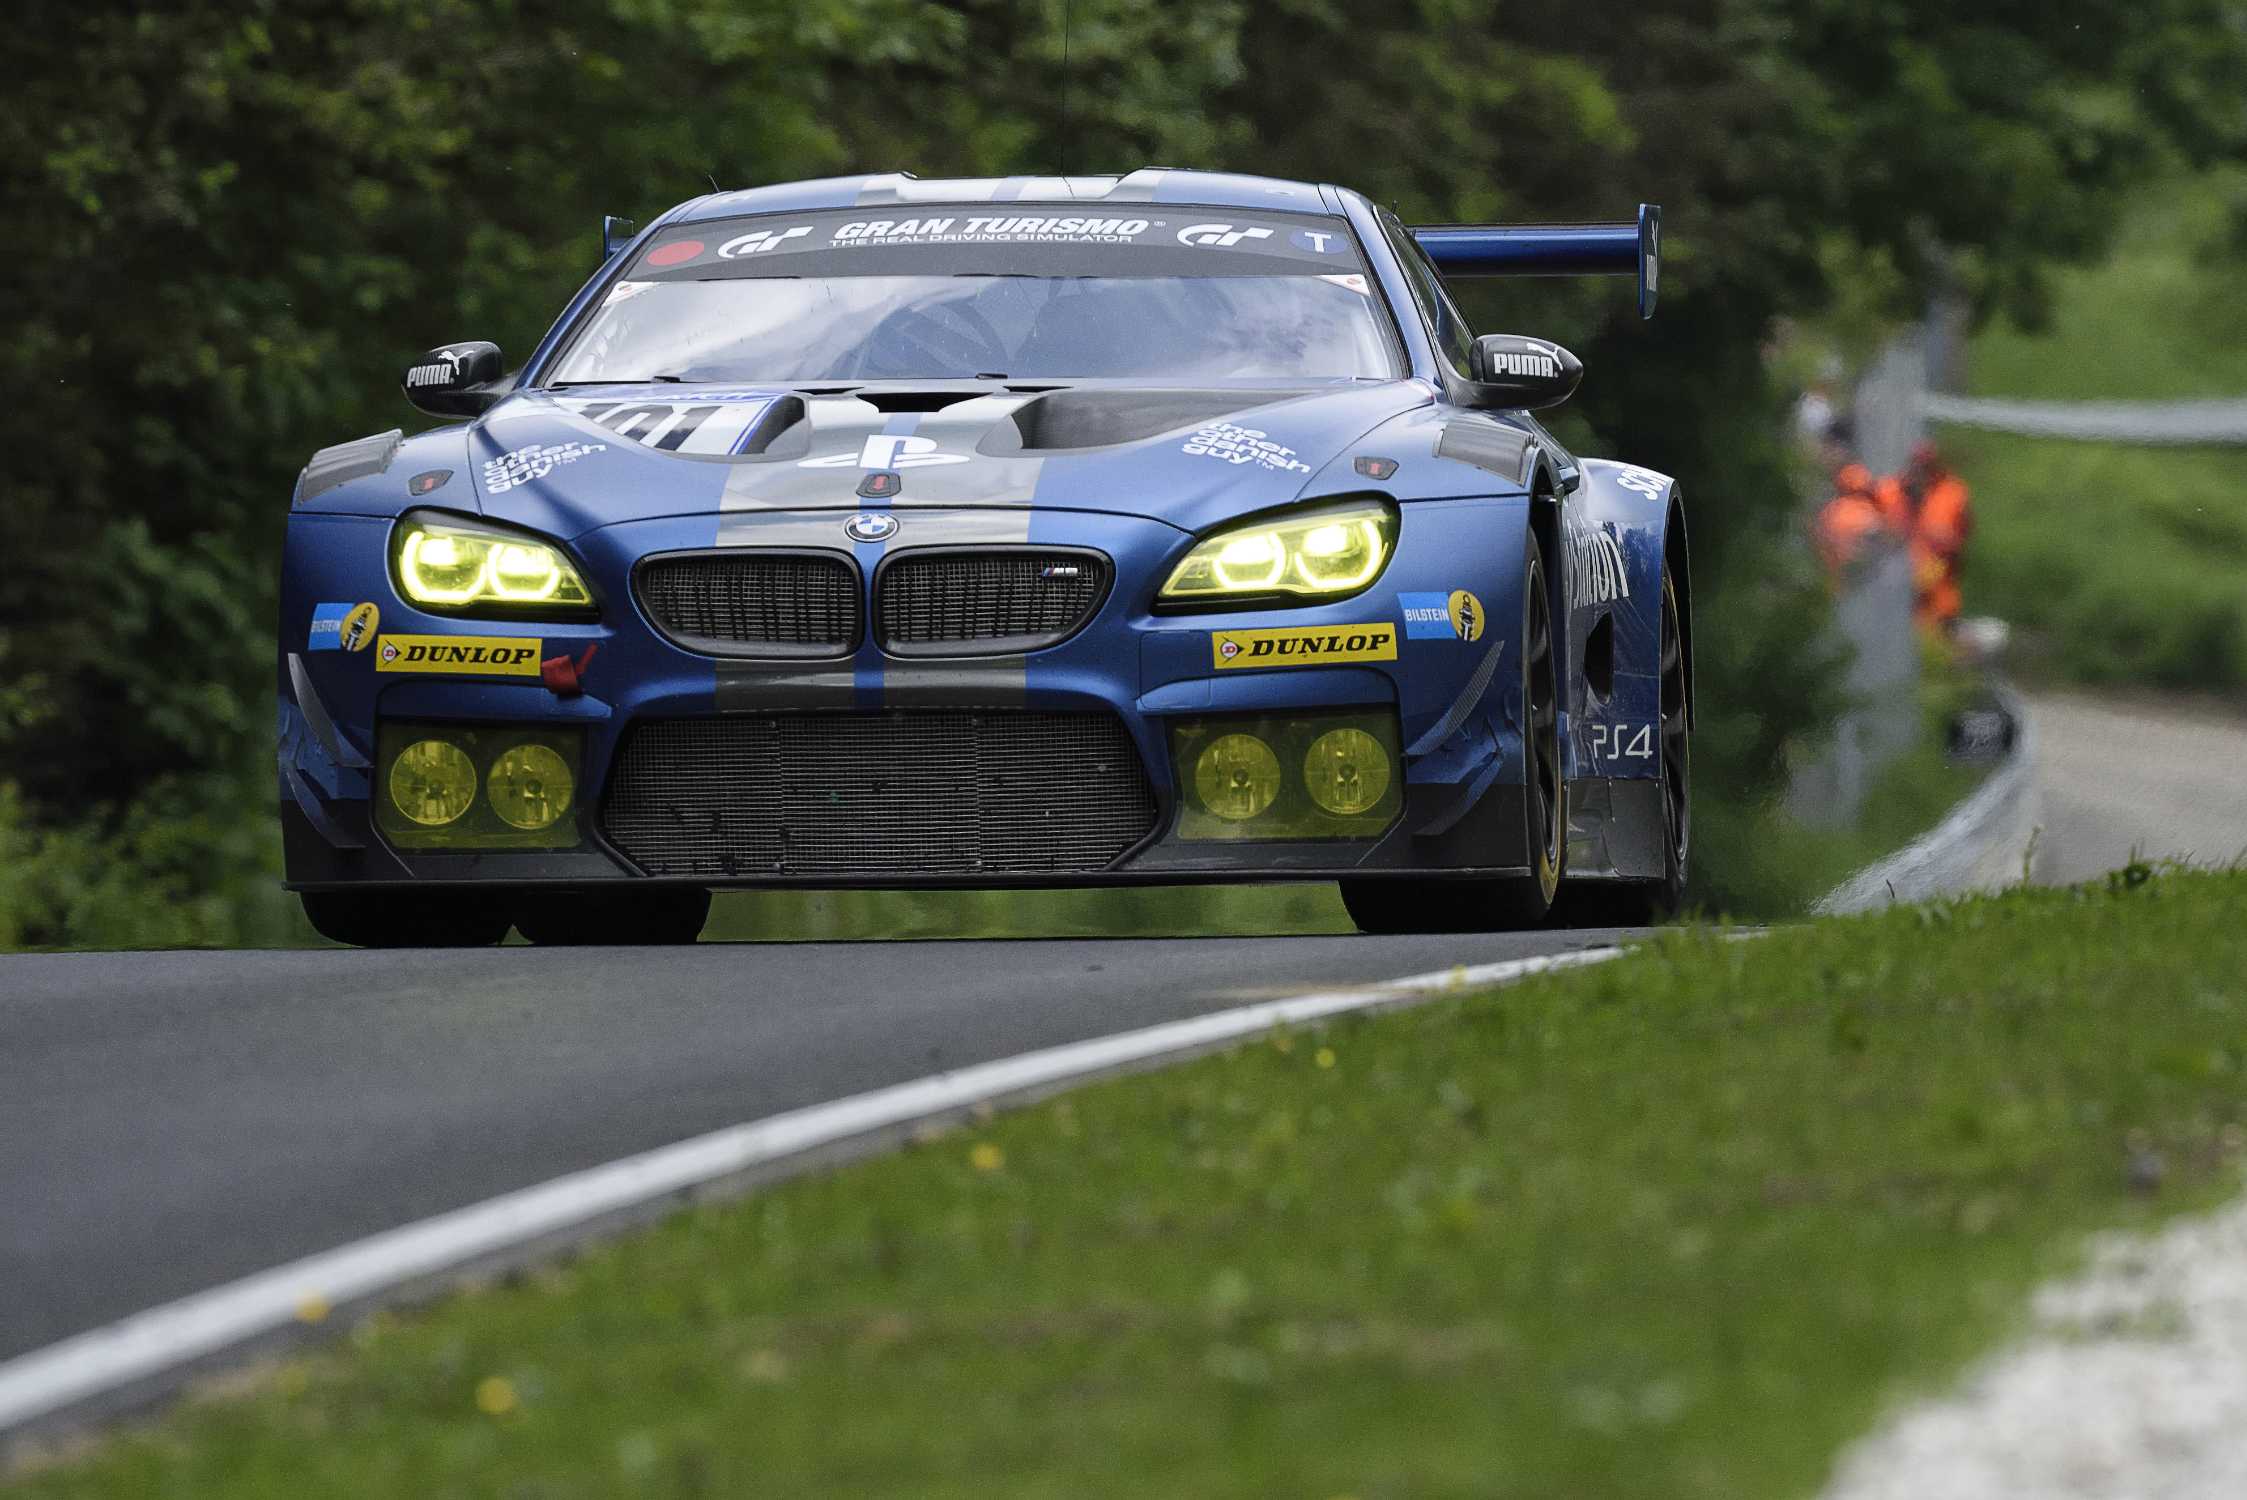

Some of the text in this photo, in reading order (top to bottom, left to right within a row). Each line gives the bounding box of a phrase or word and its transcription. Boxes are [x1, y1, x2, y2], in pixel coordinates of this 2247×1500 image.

[829, 232, 1133, 247] THE REAL DRIVING SIMULATOR
[834, 217, 956, 240] GRAN
[963, 217, 1149, 235] TURISMO
[1304, 231, 1332, 253] T
[407, 364, 453, 388] PUMA
[1494, 353, 1555, 378] PUMA
[1404, 608, 1449, 621] BILSTEIN
[404, 646, 535, 665] DUNLOP
[1248, 634, 1390, 656] DUNLOP
[1592, 724, 1653, 759] PS4
